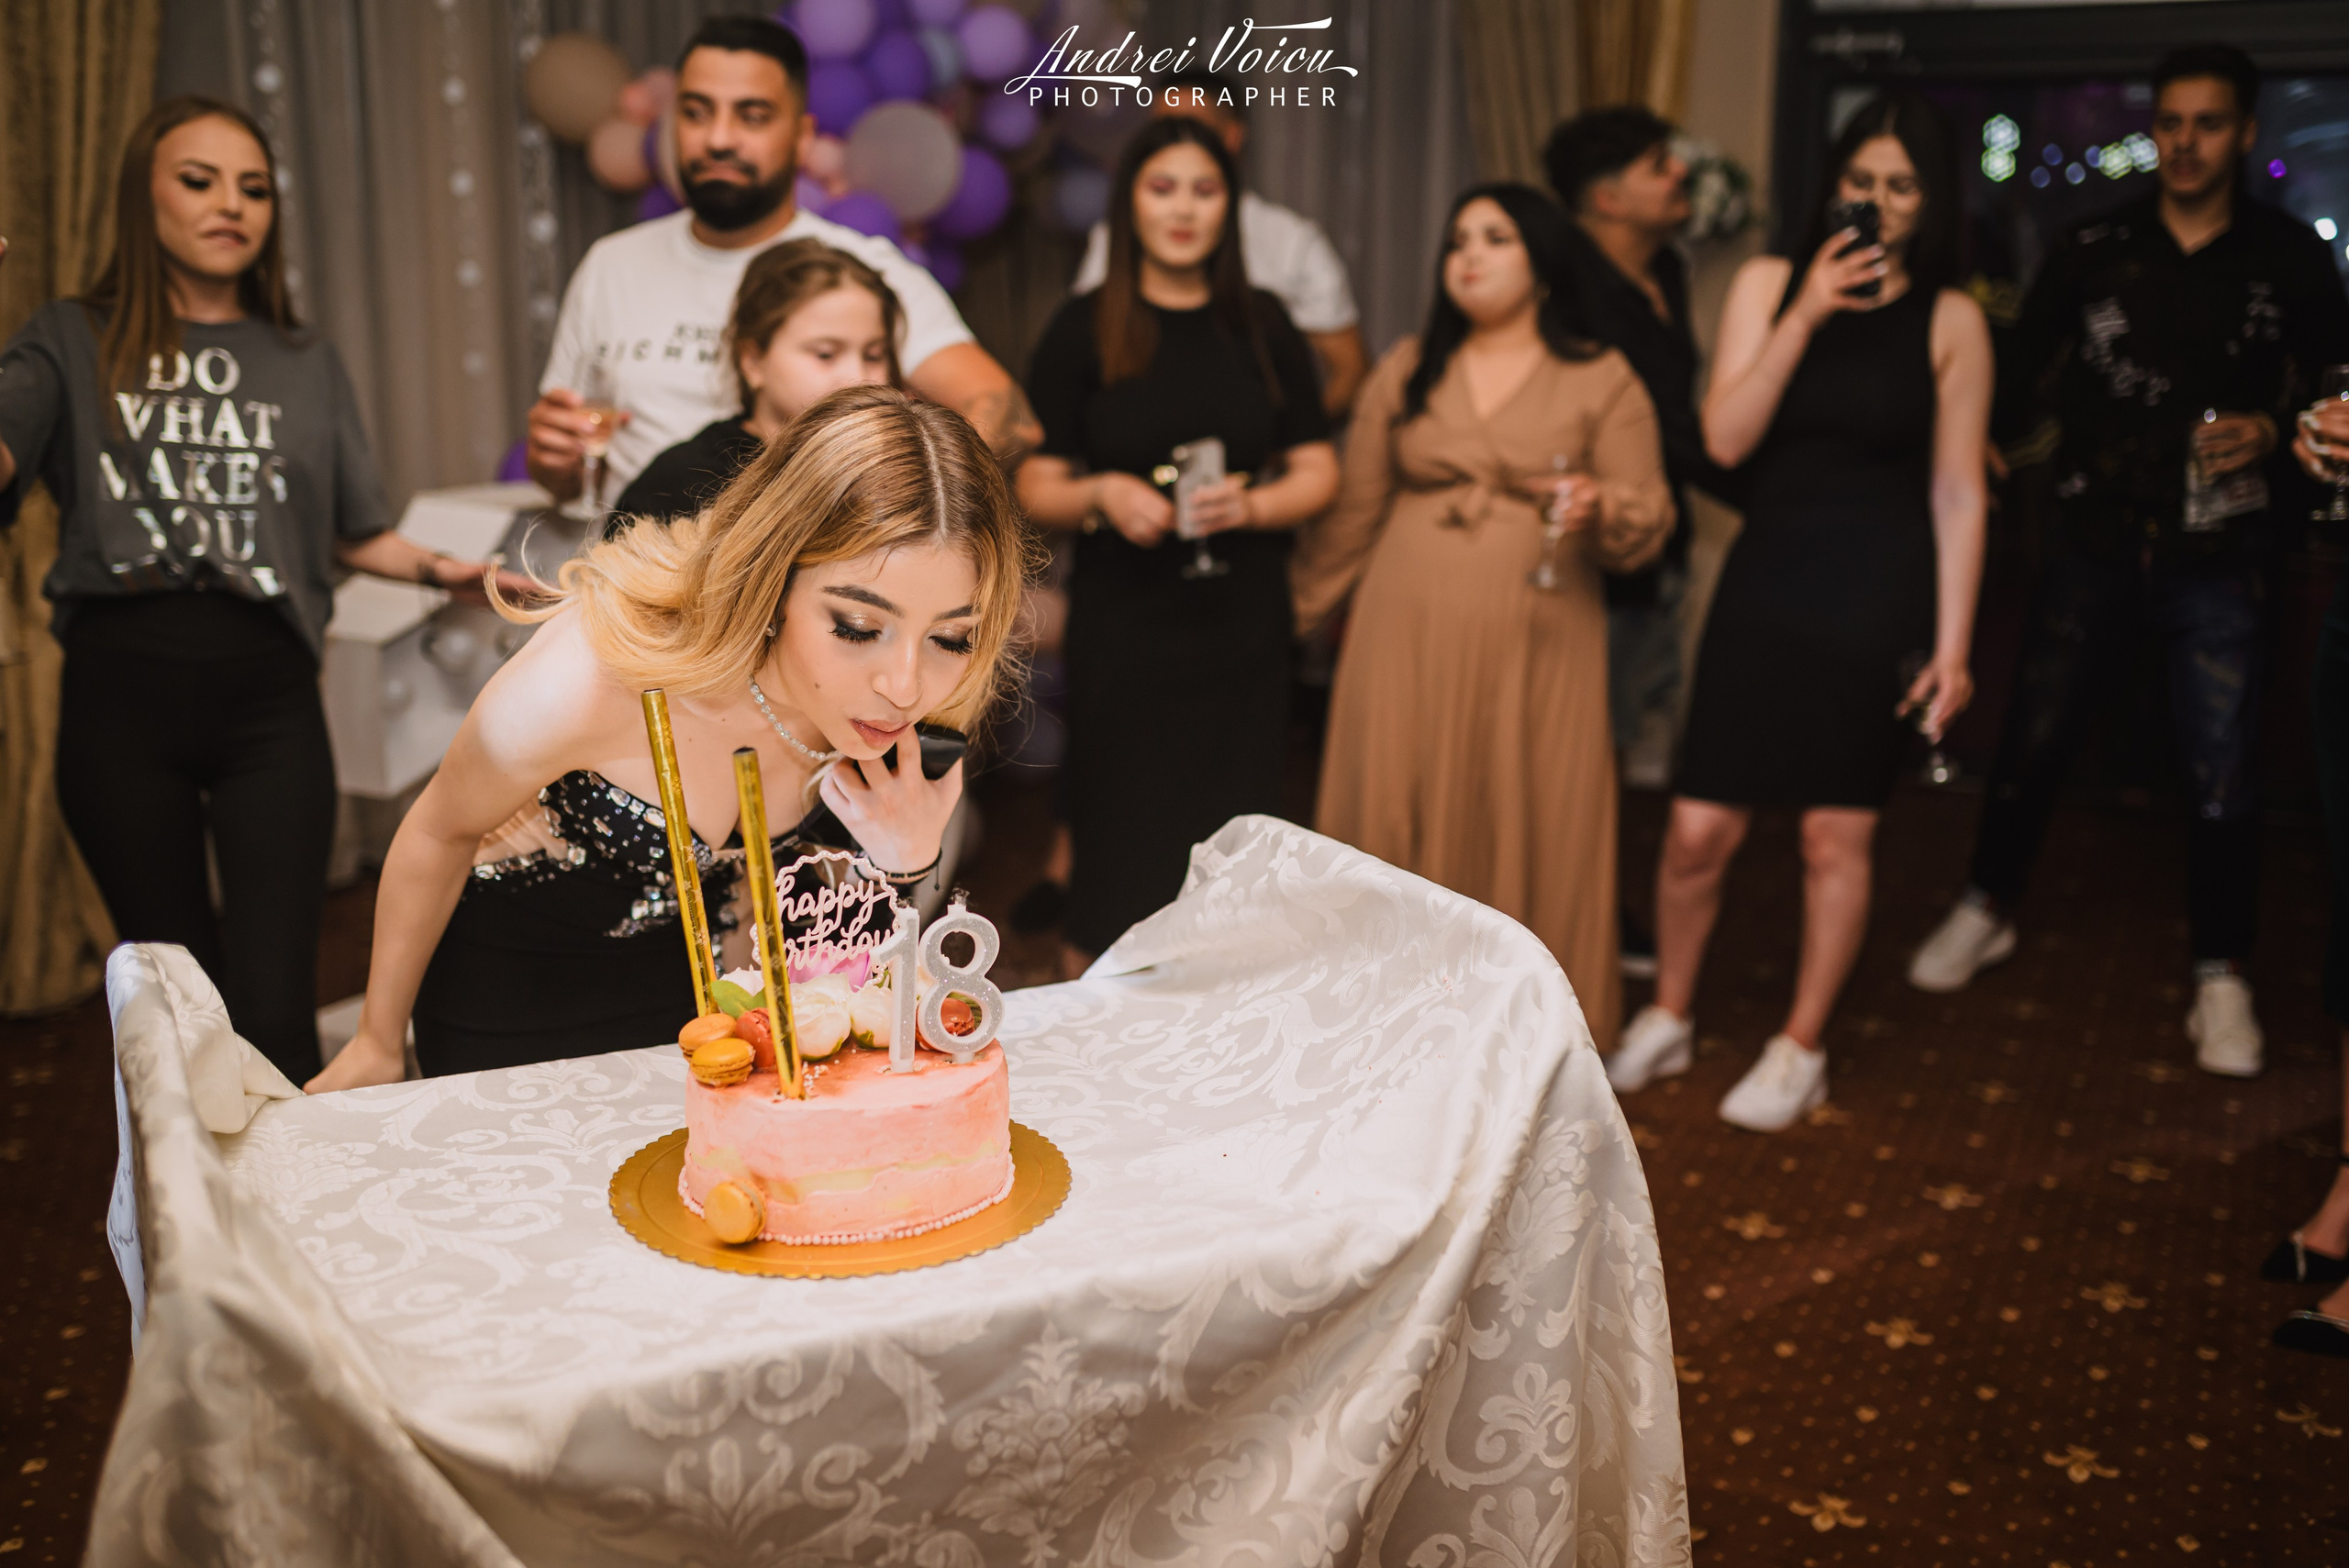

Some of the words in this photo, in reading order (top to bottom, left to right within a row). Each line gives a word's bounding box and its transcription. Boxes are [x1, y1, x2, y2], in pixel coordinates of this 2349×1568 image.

[147, 346, 241, 395] DO
[132, 505, 259, 562] YOU
[777, 874, 883, 938] happy
[783, 916, 892, 971] rthday
[868, 905, 1006, 1072] 18
